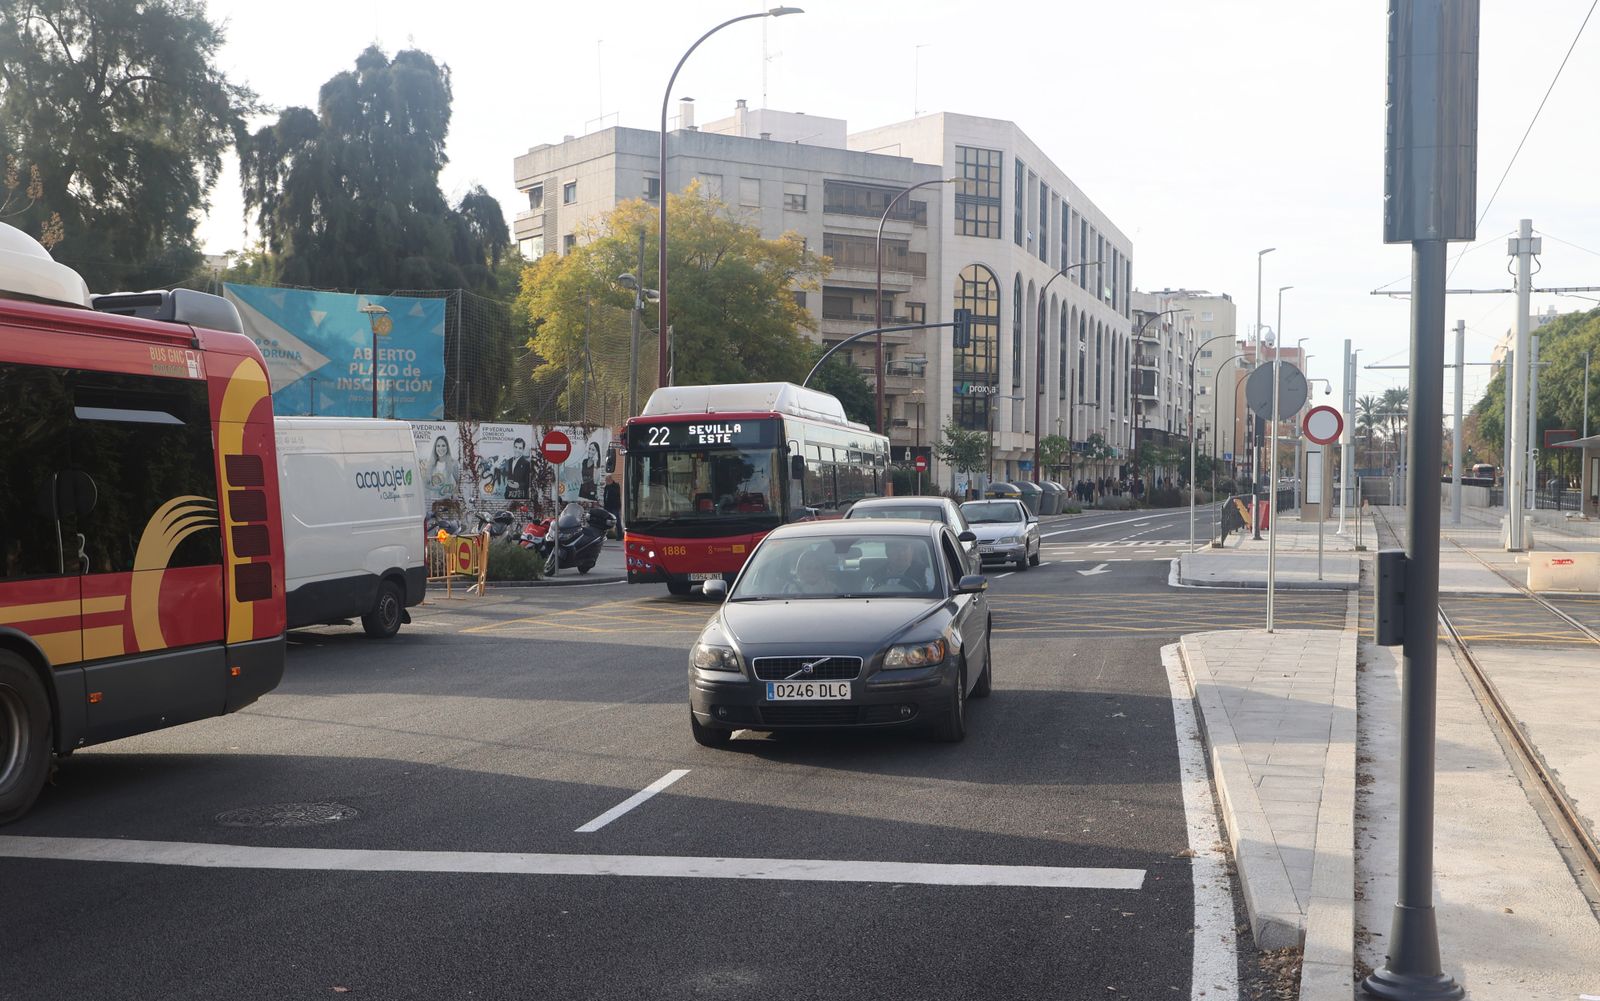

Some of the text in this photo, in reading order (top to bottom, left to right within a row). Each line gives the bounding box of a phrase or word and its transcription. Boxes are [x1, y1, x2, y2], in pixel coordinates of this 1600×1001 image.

[150, 346, 185, 363] BUS GNC
[353, 347, 416, 362] ABERTO
[402, 364, 421, 376] de
[648, 426, 670, 446] 22
[688, 424, 742, 435] SEVILLA
[698, 433, 732, 444] ESTE
[355, 465, 406, 492] acquajet
[662, 546, 686, 556] 1886
[776, 684, 848, 698] 0246 DLC
